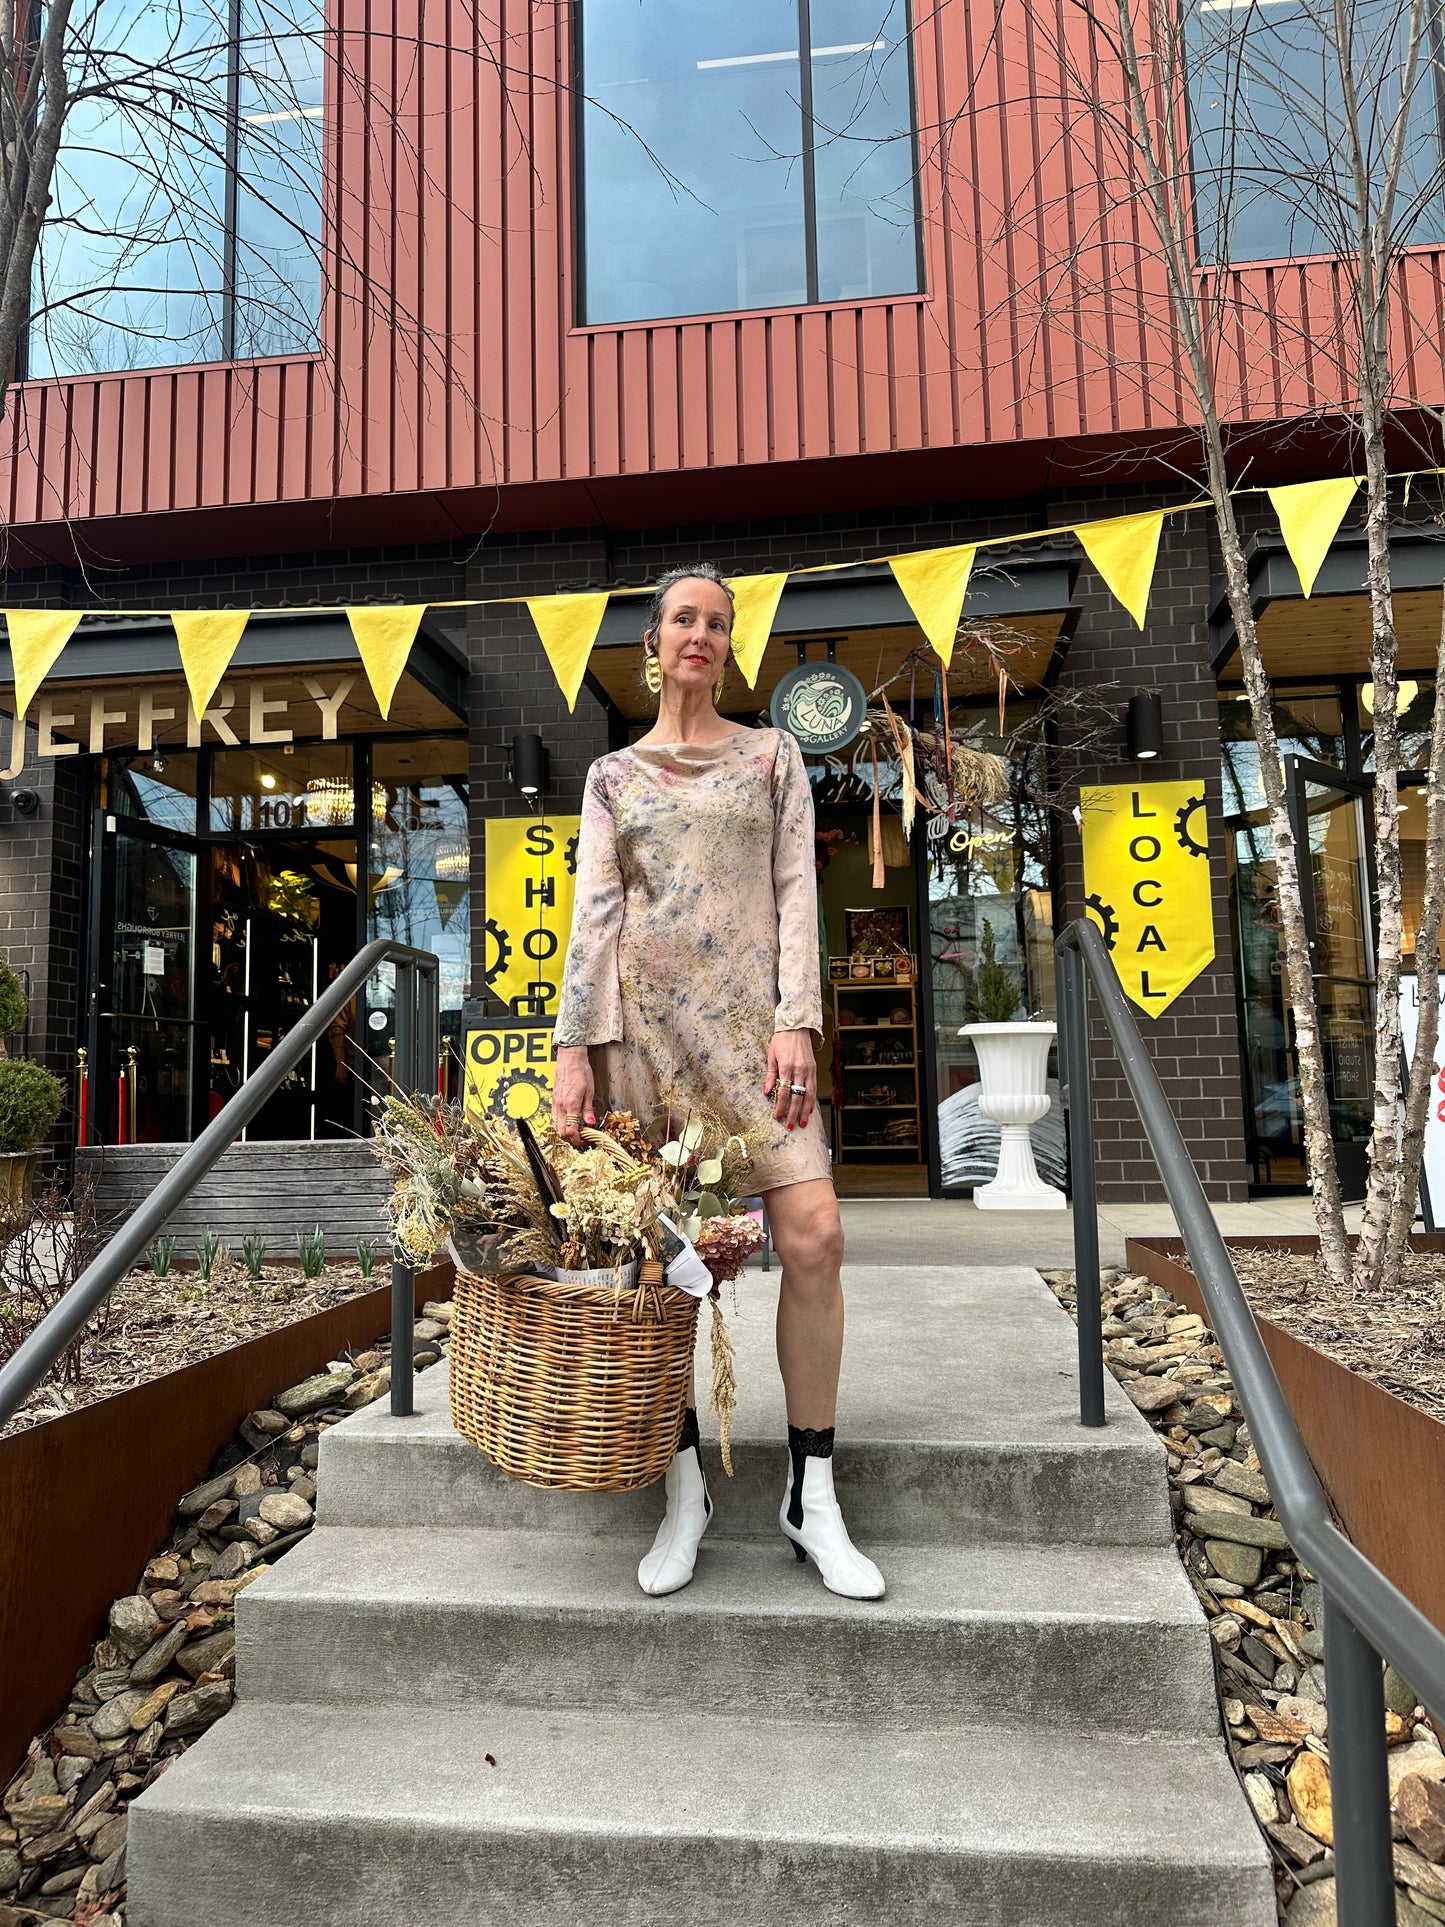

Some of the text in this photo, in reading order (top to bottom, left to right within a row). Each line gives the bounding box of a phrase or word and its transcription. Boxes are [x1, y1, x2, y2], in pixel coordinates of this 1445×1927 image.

[0, 675, 358, 781] JEFFREY
[800, 708, 843, 731] LUNA
[809, 726, 848, 744] GALLERY
[258, 800, 305, 827] 101
[950, 829, 1016, 860] Open
[1129, 792, 1167, 998] LOCAL
[523, 825, 558, 1013] SHOP
[471, 1031, 558, 1065] OPE
